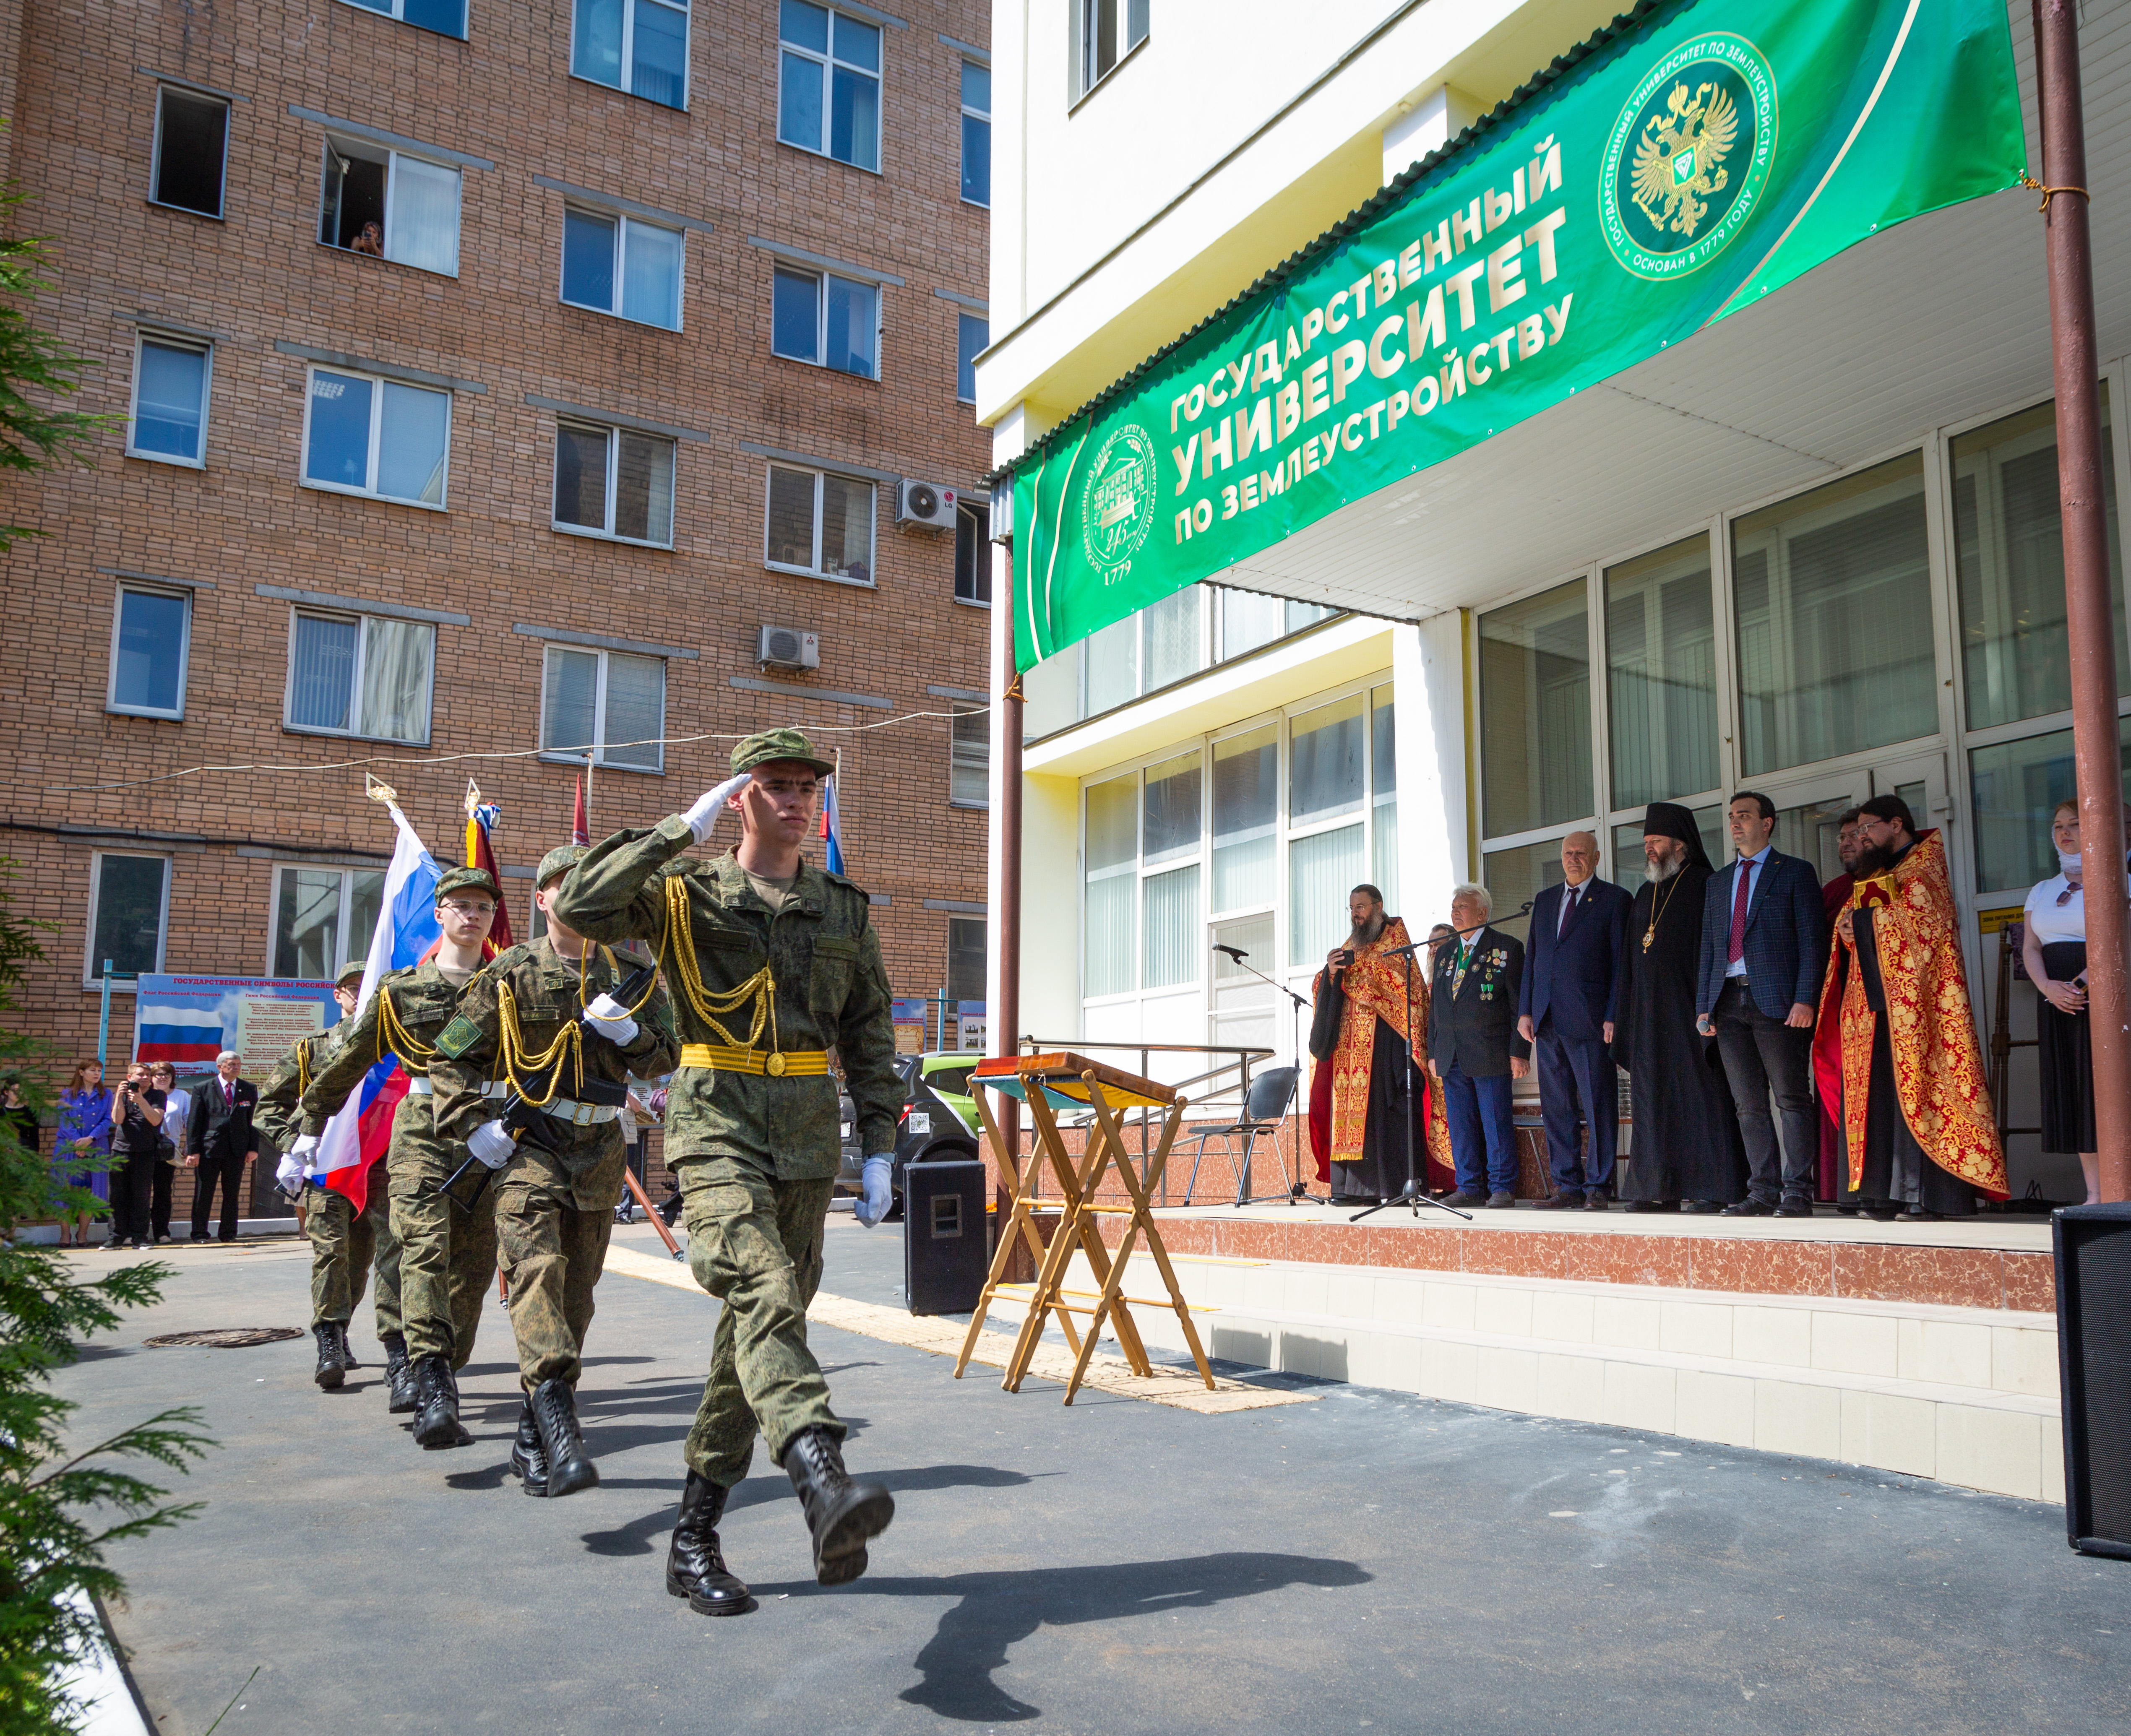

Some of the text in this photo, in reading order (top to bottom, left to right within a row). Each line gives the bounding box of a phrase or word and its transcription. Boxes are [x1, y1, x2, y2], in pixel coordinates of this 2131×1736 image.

[1605, 42, 1773, 247] ГОСУДАРСТВЕННЫЙ УНИВЕРСИТЕТ ПО ЗЕМЛЕУСТРОЙСТВУ
[1170, 133, 1562, 434] ГОСУДАРСТВЕННЫЙ
[1633, 189, 1752, 272] ОСНОВАН В 1779 ГОДУ
[1171, 206, 1566, 496] УНИВЕРСИТЕТ
[1175, 292, 1573, 545] ПО ЗЕМЛЕУСТРОЙСТВУ
[1093, 424, 1140, 468] УНИВЕРСИТЕТ
[1139, 427, 1147, 441] ПО
[1104, 560, 1131, 586] 1779
[1105, 519, 1129, 556] 245
